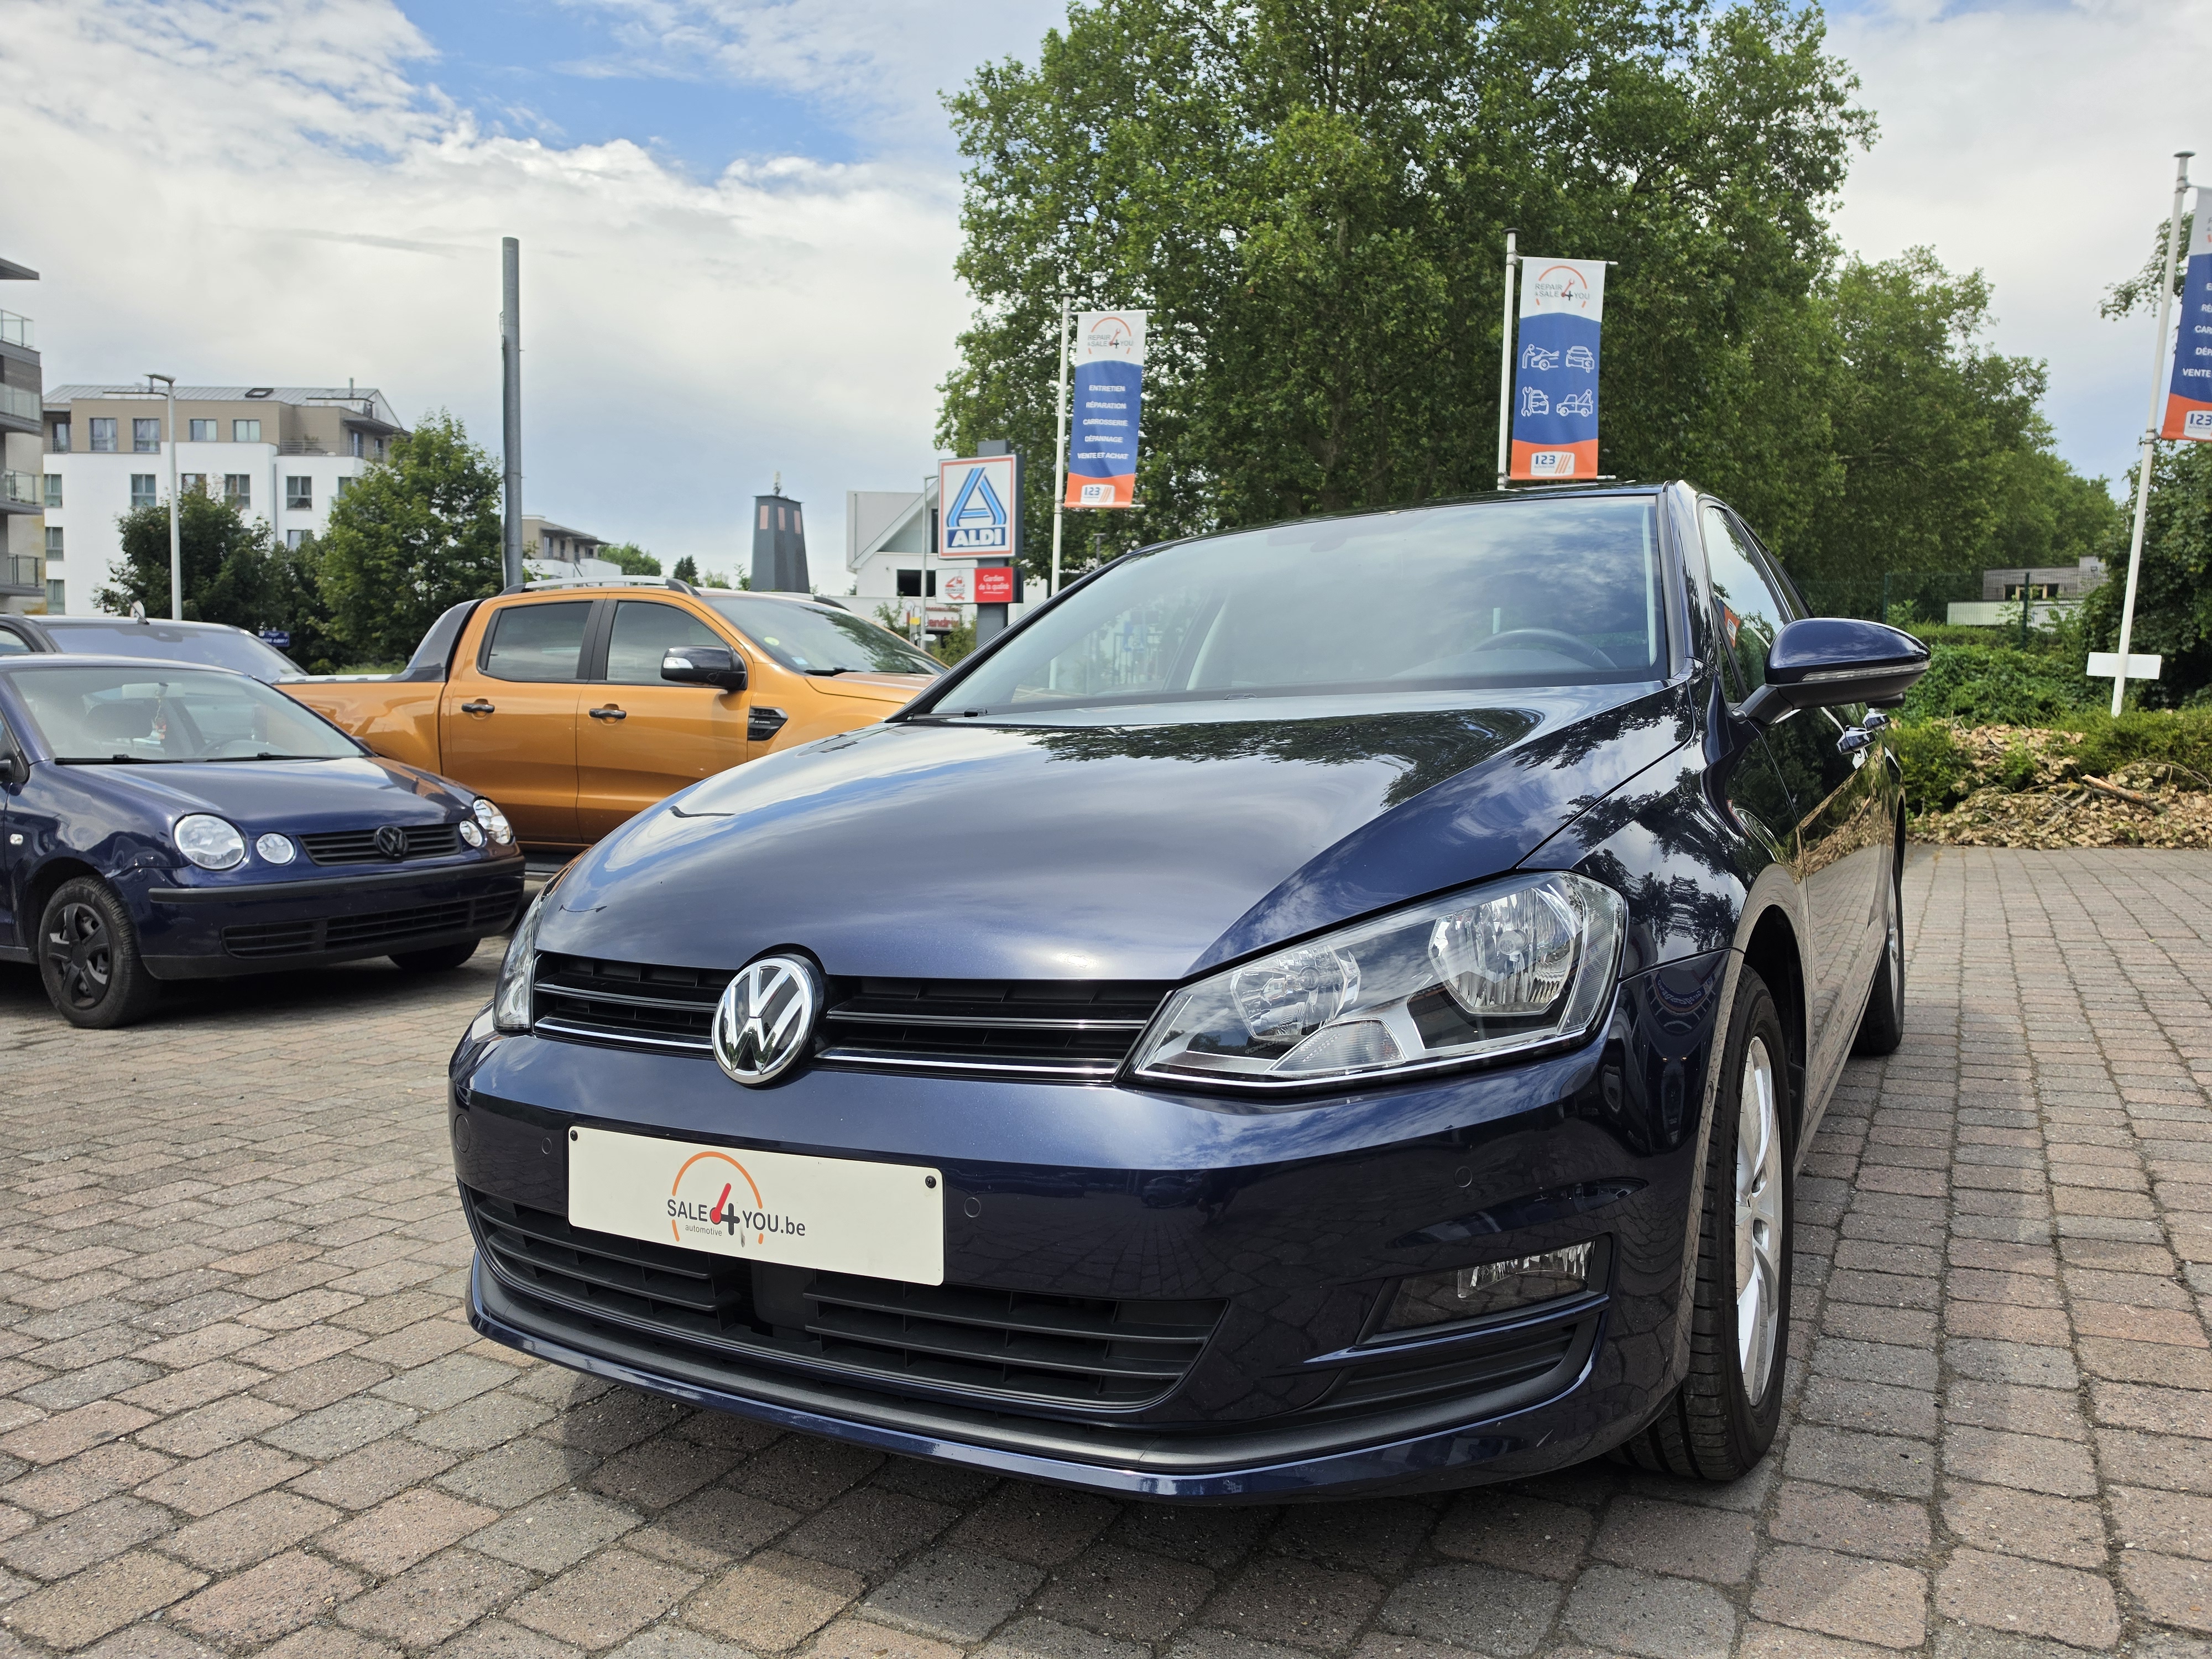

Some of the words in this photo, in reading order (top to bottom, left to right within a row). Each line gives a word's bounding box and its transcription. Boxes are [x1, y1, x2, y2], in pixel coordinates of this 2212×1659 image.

[1086, 401, 1126, 409] RÉPARATION
[951, 529, 1002, 547] ALDI
[685, 1224, 722, 1237] automotive
